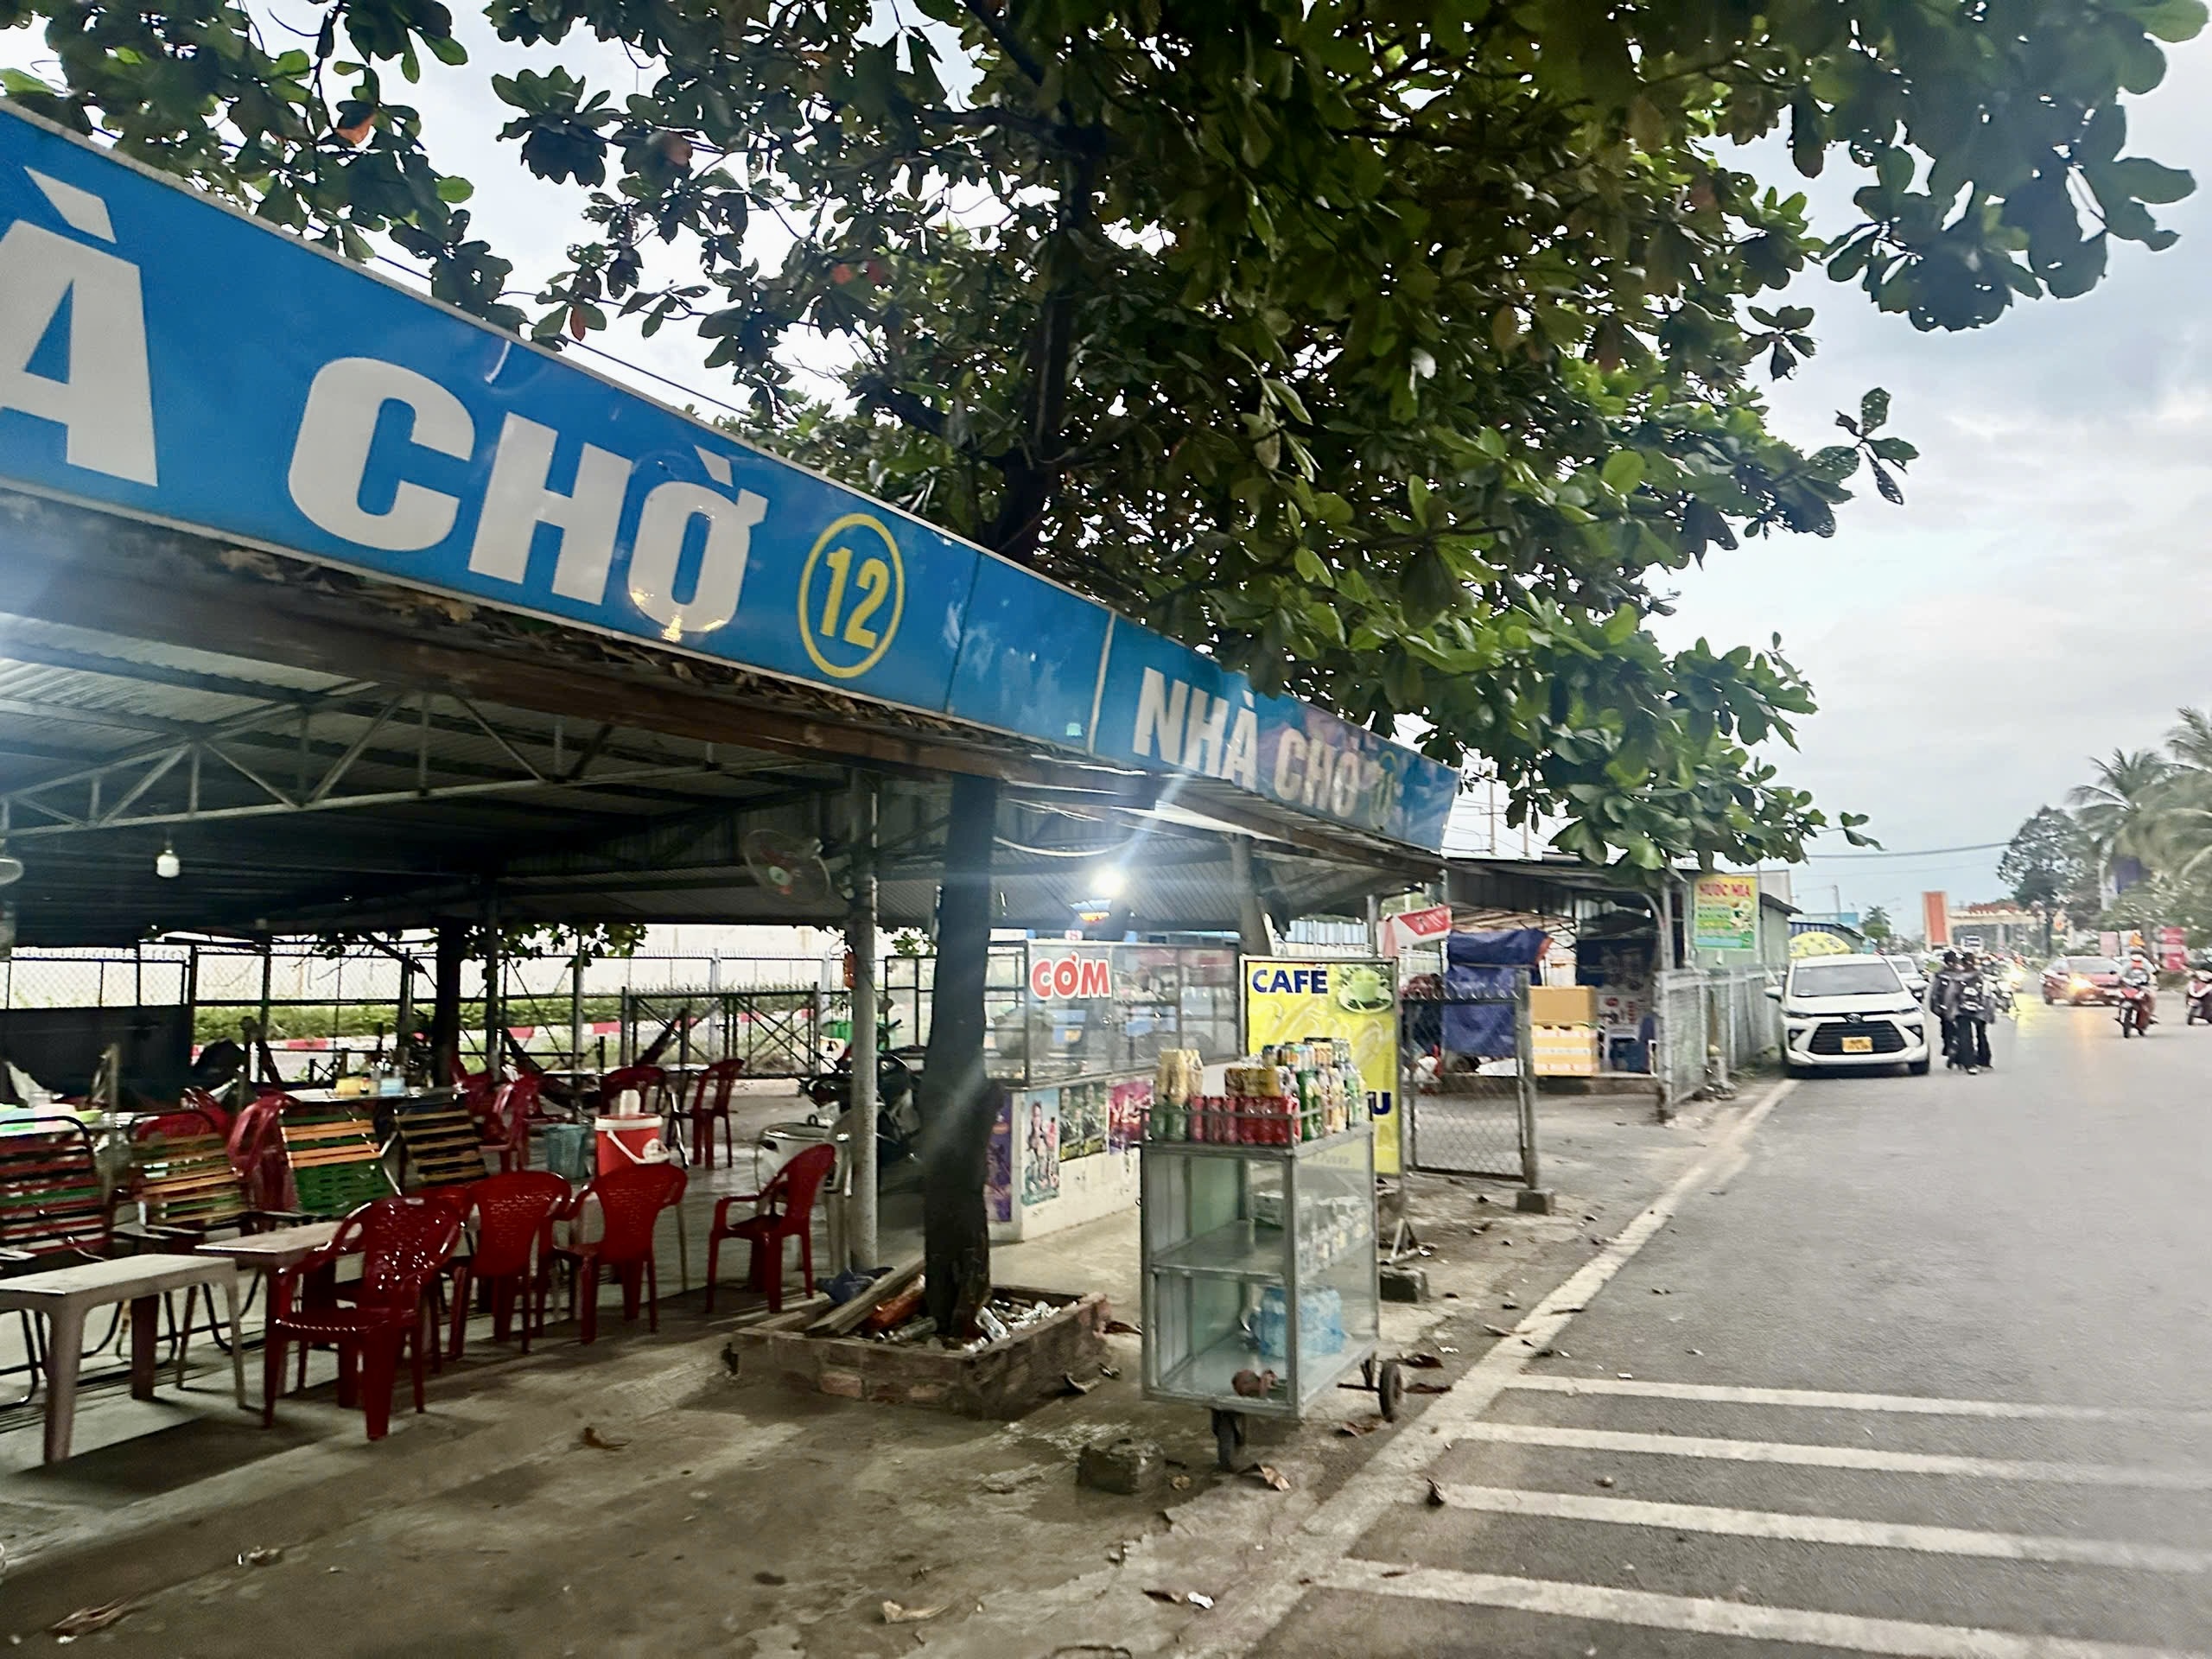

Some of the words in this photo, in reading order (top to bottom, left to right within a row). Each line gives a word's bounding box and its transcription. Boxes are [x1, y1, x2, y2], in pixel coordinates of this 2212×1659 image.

[289, 357, 768, 632] CHỜ
[820, 546, 890, 649] 12
[1133, 666, 1257, 791] NHÀ
[1031, 952, 1111, 1000] CƠM
